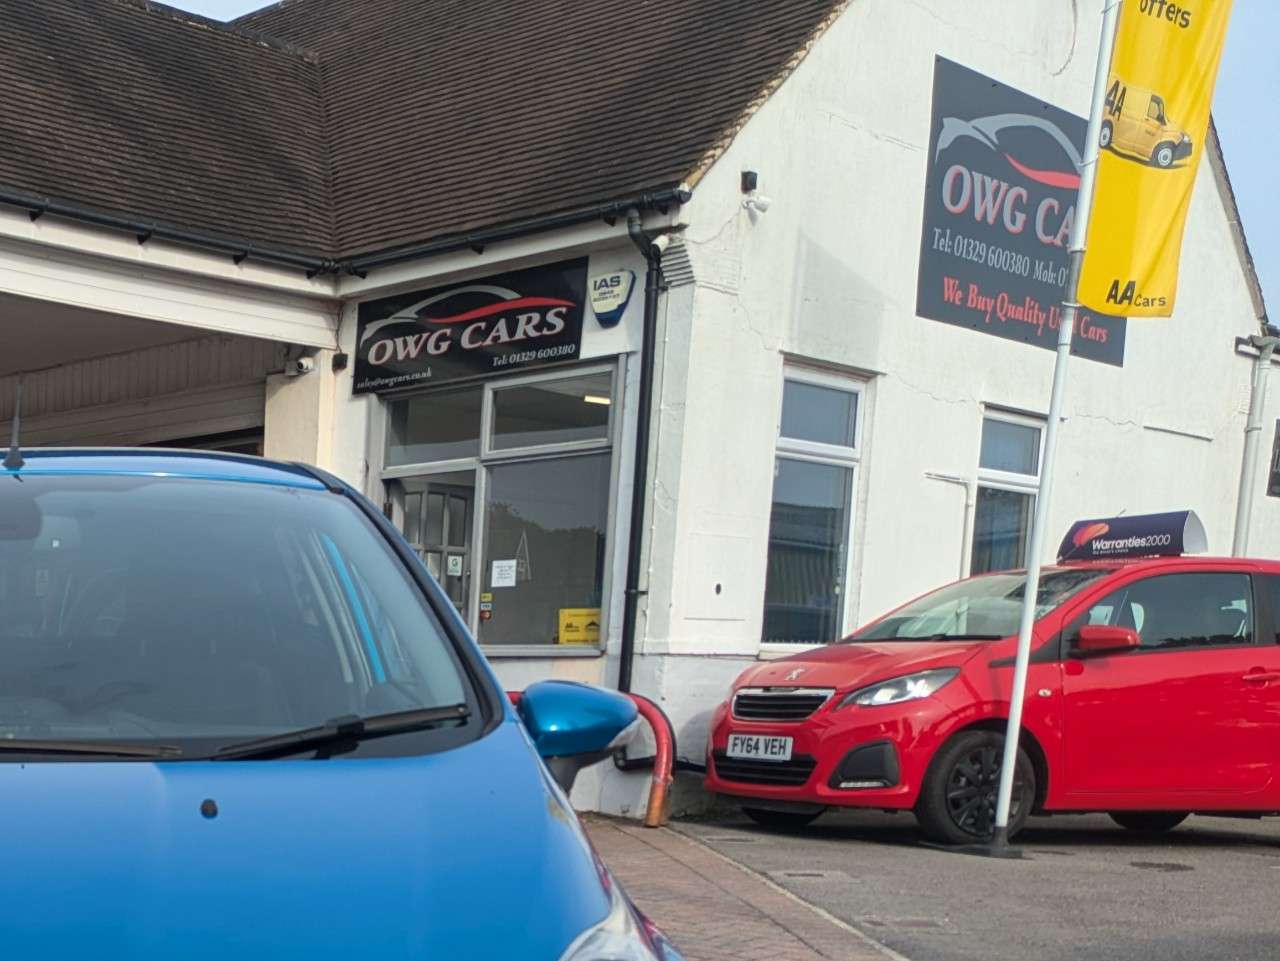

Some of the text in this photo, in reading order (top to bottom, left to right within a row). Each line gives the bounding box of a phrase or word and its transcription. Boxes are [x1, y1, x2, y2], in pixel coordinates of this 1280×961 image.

[1139, 0, 1191, 29] offers
[942, 164, 1078, 254] OWG CA
[932, 227, 953, 254] Tel:
[953, 235, 987, 264] 01329
[987, 245, 1030, 277] 600380
[1033, 260, 1057, 285] Mob:
[593, 275, 621, 291] IAS
[1105, 279, 1167, 308] AA Cars
[943, 276, 963, 305] We
[967, 283, 995, 323] Buy
[996, 292, 1047, 337] Quality
[1080, 315, 1108, 343] Cars
[367, 307, 568, 366] OWG CARS
[493, 343, 576, 367] Tel: 01329 600380
[731, 736, 787, 756] FY64 VEH
